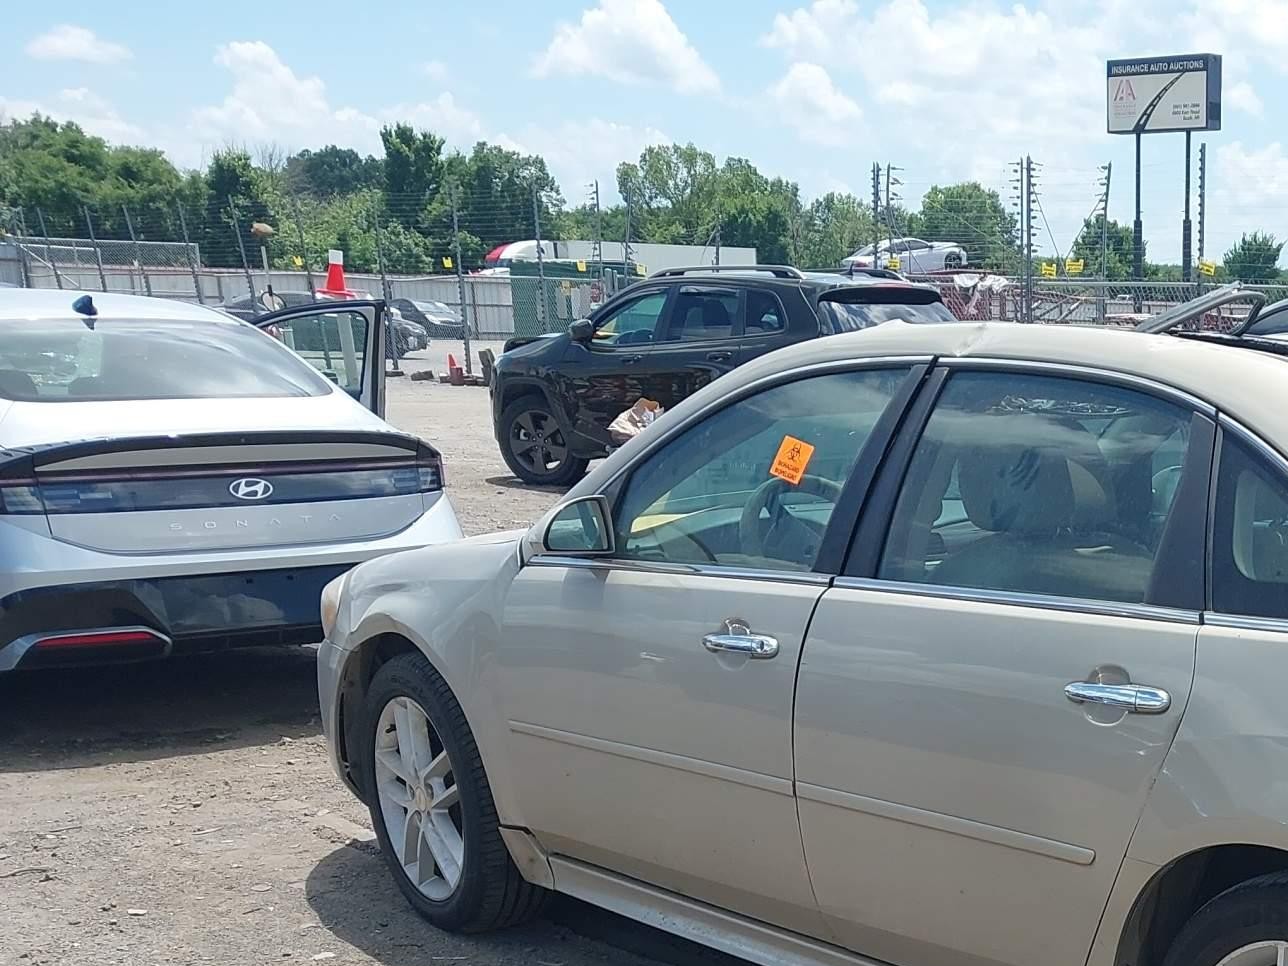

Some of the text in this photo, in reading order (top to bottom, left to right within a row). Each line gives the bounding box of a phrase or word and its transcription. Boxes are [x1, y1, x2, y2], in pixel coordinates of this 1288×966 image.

[1111, 59, 1204, 75] INSURANCE AUTO AUCTIONS
[169, 513, 341, 531] SONATA
